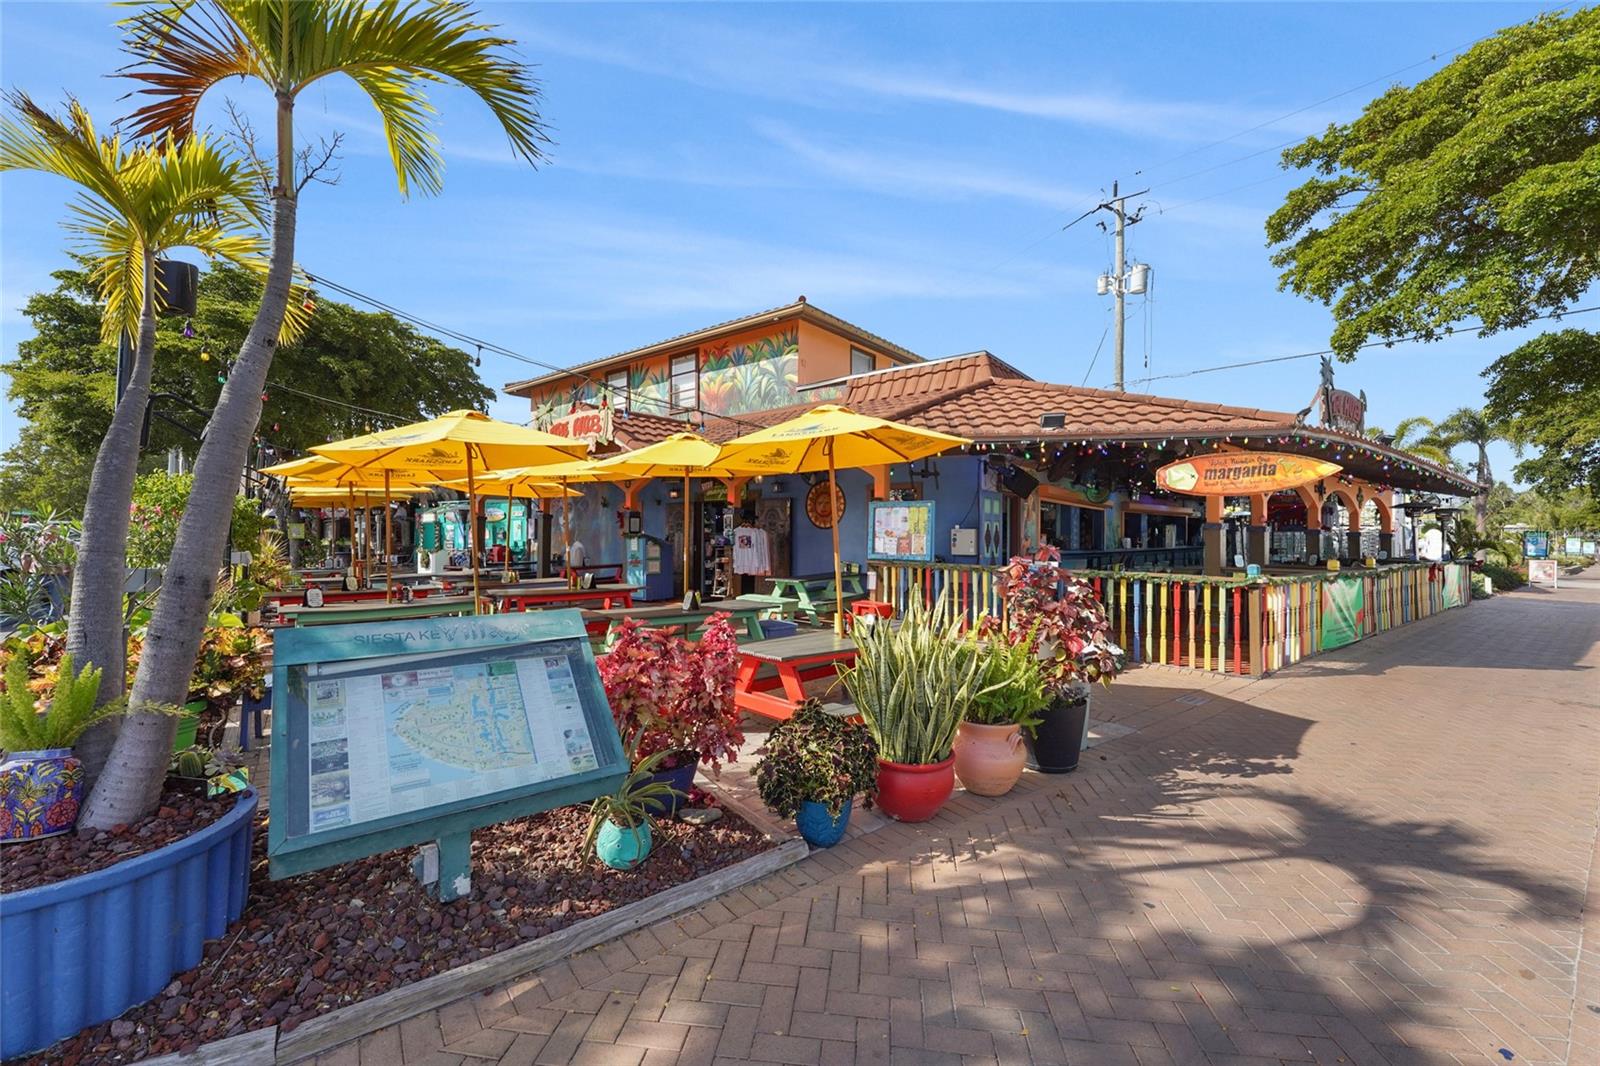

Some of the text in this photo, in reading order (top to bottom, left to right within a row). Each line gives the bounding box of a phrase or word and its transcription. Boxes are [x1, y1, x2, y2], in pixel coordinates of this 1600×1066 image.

[1204, 463, 1277, 481] margarita
[353, 632, 416, 646] SIESTA
[419, 626, 450, 642] KEY
